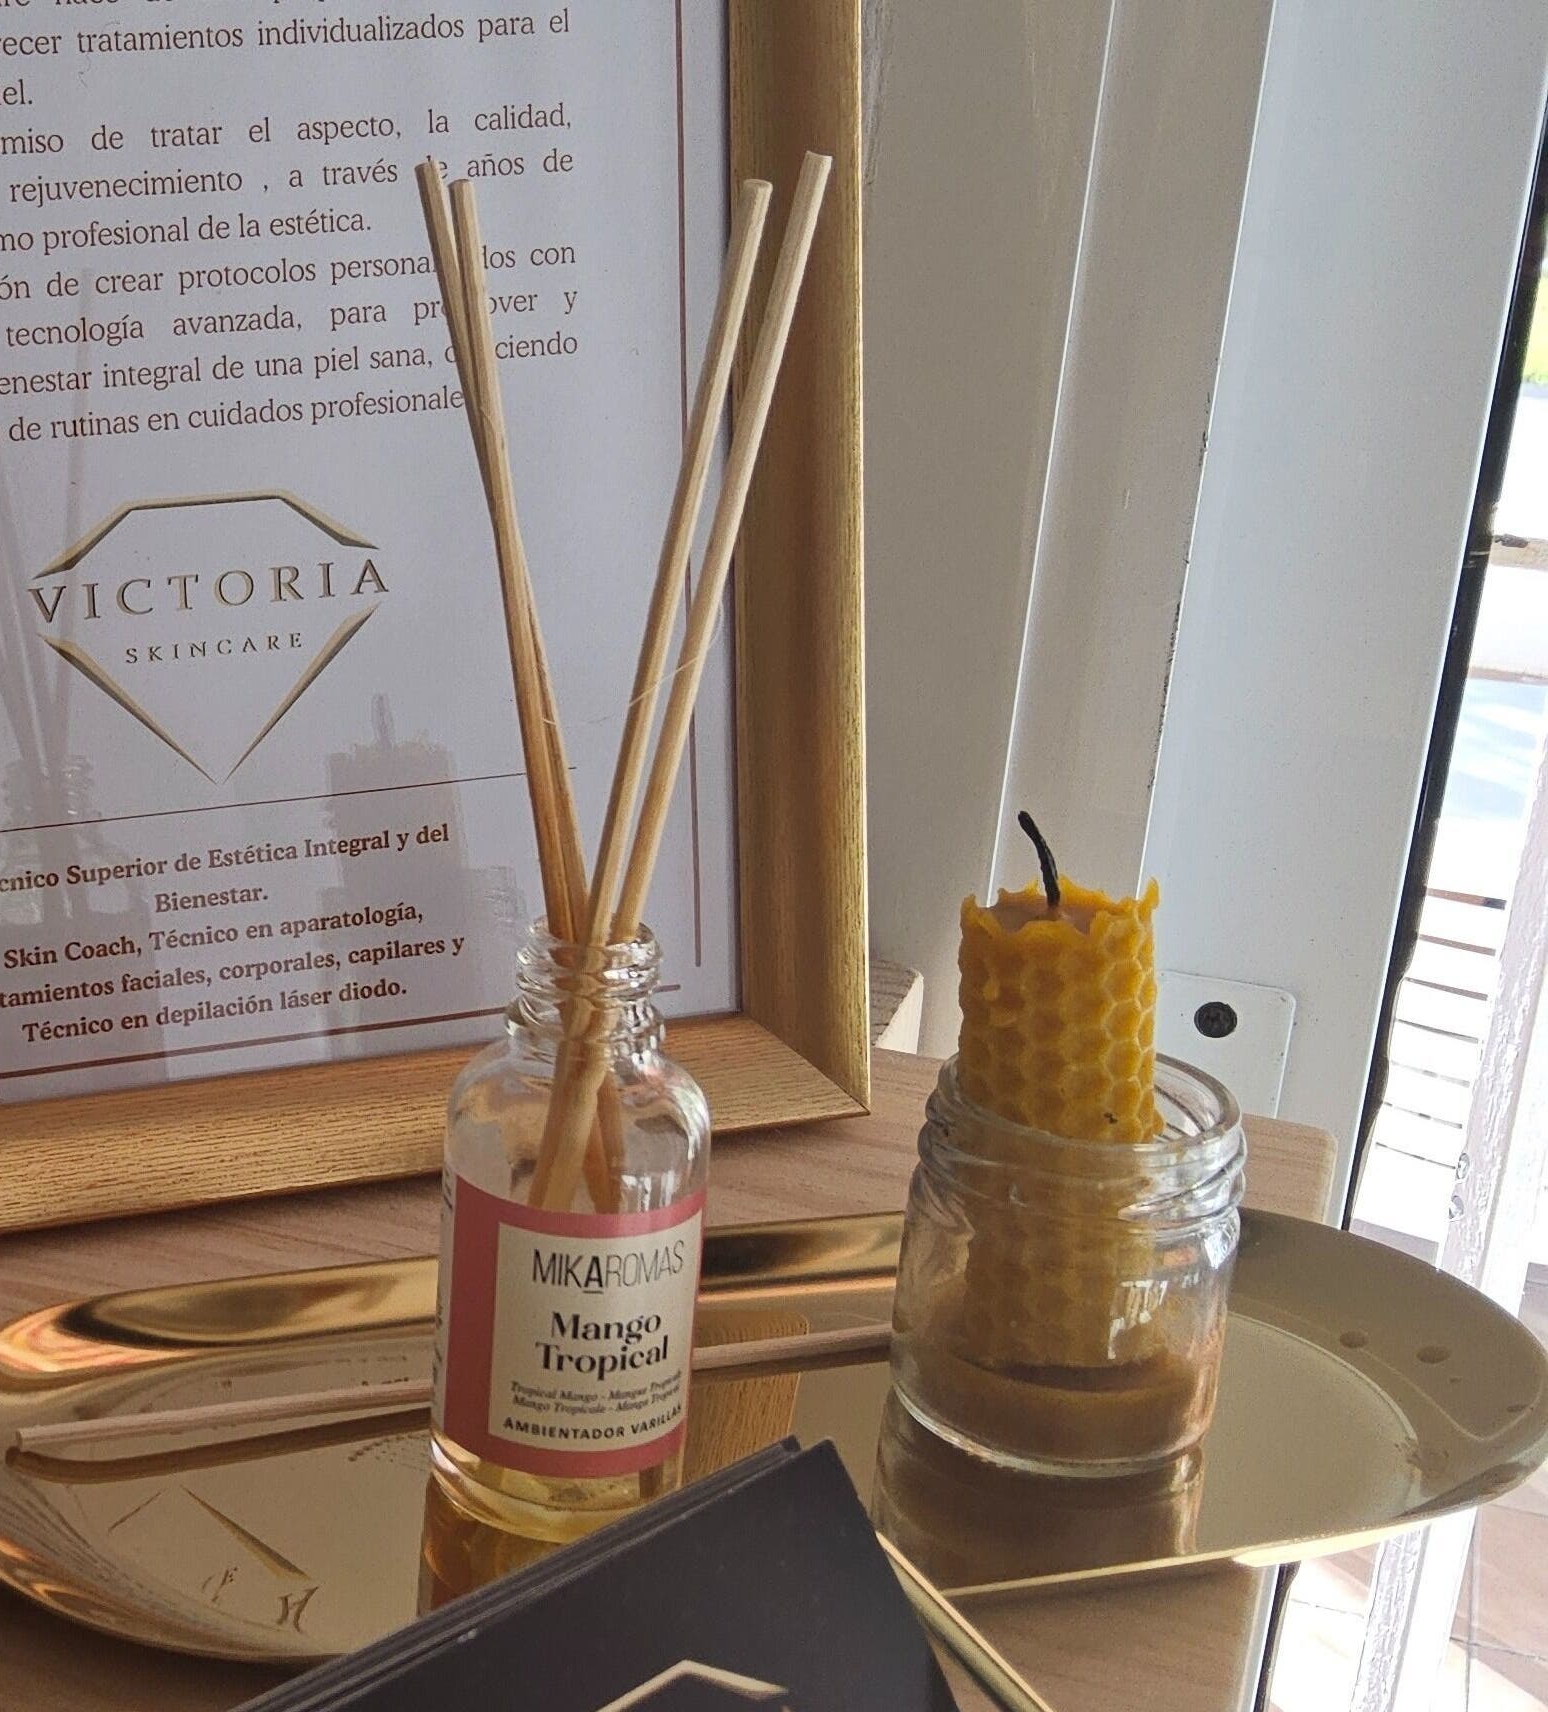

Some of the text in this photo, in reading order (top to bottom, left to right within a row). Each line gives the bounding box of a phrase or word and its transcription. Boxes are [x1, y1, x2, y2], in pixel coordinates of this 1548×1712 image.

[77, 25, 243, 53] tratamientos
[258, 14, 464, 45] individualizados
[478, 17, 535, 43] para
[550, 8, 568, 33] el
[92, 125, 123, 150] de
[151, 126, 222, 147] tratar
[249, 117, 270, 142] el
[298, 117, 400, 145] aspecto,
[428, 109, 449, 133] la
[475, 102, 570, 131] calidad,
[10, 169, 242, 207] rejuvenecimiento
[289, 170, 303, 187] a
[323, 158, 397, 185] través
[418, 153, 448, 178] e
[468, 154, 524, 177] años
[543, 148, 573, 172] de
[43, 217, 188, 255] profesional
[199, 215, 229, 240] de
[239, 213, 260, 237] la
[270, 209, 370, 236] estética.
[47, 272, 78, 296] de
[96, 273, 163, 294] crear
[179, 258, 316, 295] protocolos
[531, 247, 575, 266] con
[6, 315, 144, 347] tecnología
[174, 305, 301, 336] avanzada,
[331, 305, 386, 331] para
[564, 291, 577, 314] y
[104, 357, 201, 390] integral
[213, 355, 244, 379] de
[255, 358, 302, 376] una
[314, 346, 359, 379] piel
[370, 349, 432, 369] sana,
[9, 417, 41, 441] de
[51, 412, 139, 438] rutinas
[148, 413, 179, 431] en
[189, 399, 302, 428] cuidados
[28, 558, 389, 624] VICTORIA
[126, 633, 301, 663] SKINCARE
[67, 858, 167, 885] Superior
[174, 853, 201, 872] de
[208, 843, 298, 868] Estética
[305, 830, 389, 857] Integral
[397, 833, 409, 851] y
[417, 823, 449, 844] del
[155, 888, 268, 912] Bienestar.
[4, 902, 422, 968] Skin Coach, Técnico en aparatología,
[122, 968, 211, 992] faciales,
[220, 952, 340, 980] corporales,
[349, 940, 445, 965] capilares
[452, 937, 464, 956] y
[22, 979, 406, 1042] Técnico en depilación láser diodo.
[532, 1240, 684, 1294] MIKAROMAS
[552, 1312, 662, 1344] Mango
[536, 1336, 668, 1380] Tropical
[503, 1416, 625, 1440] AMBIENTADOR
